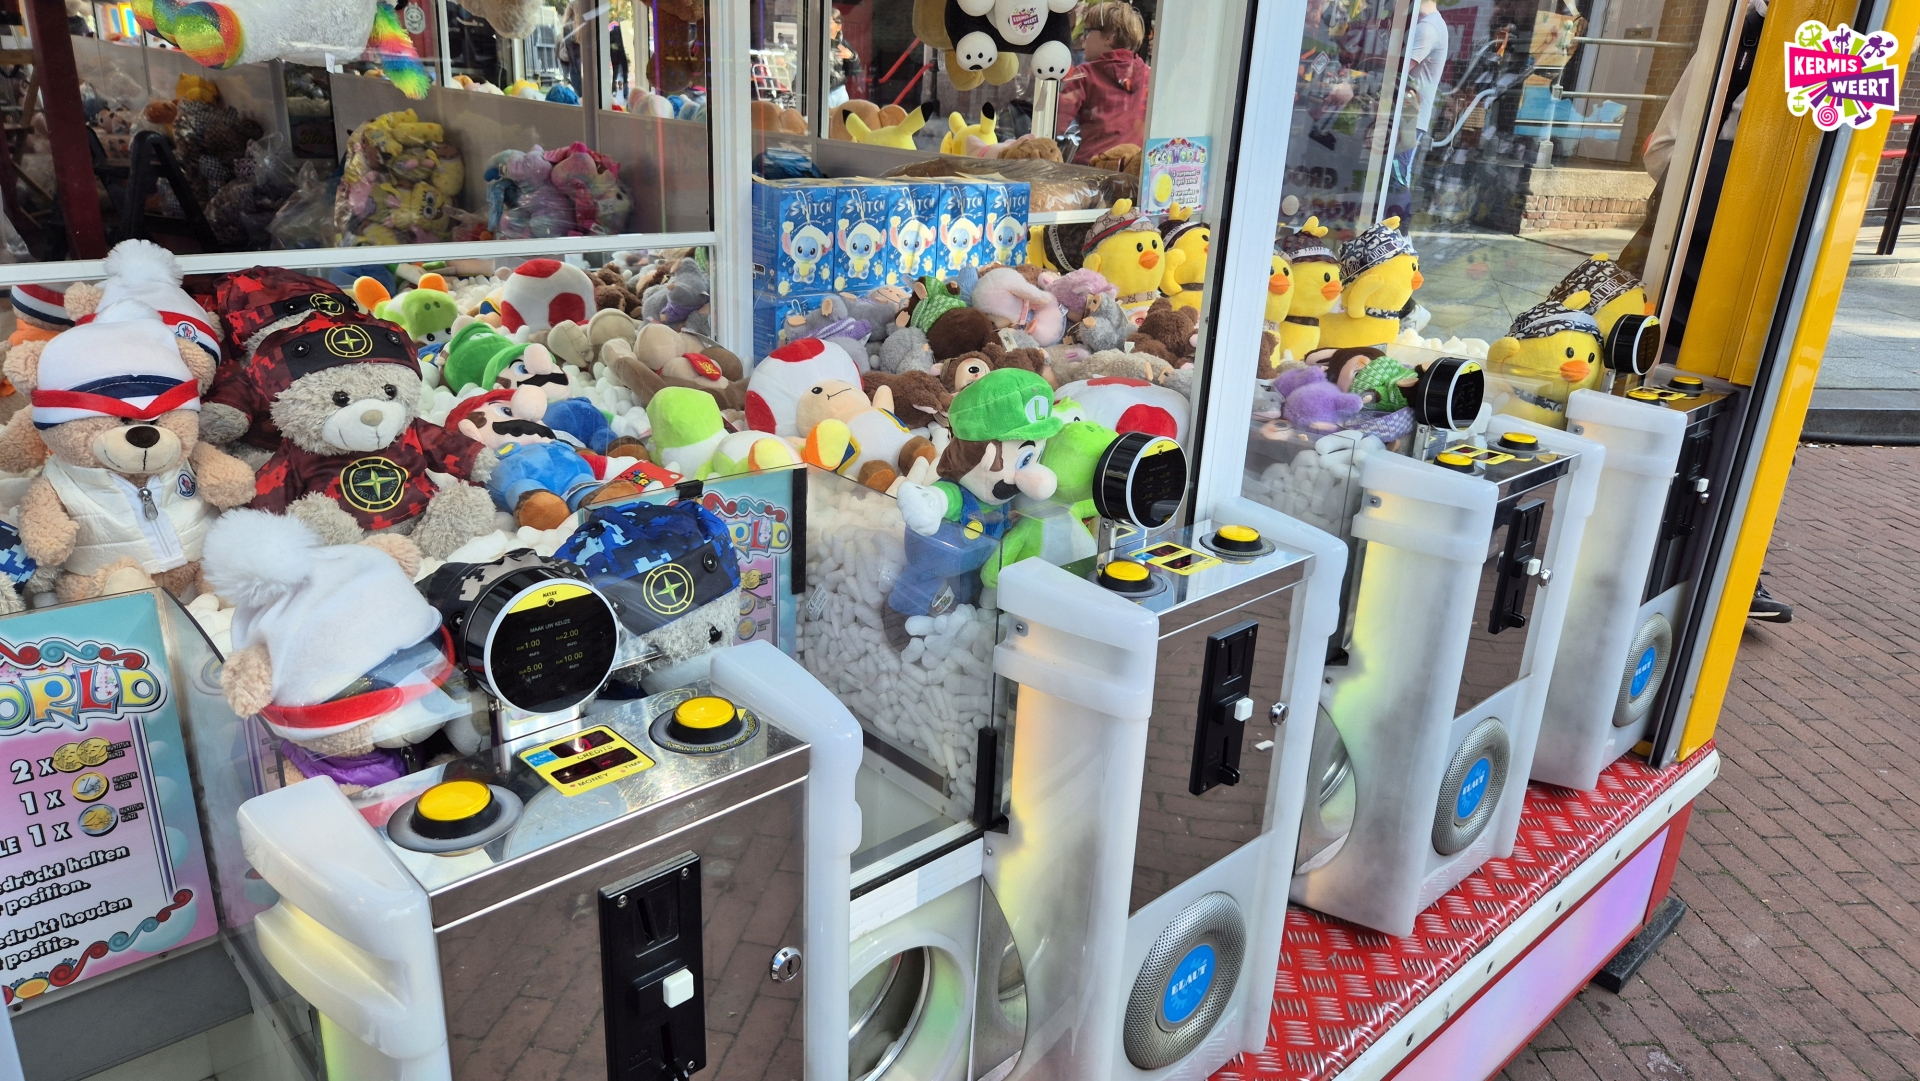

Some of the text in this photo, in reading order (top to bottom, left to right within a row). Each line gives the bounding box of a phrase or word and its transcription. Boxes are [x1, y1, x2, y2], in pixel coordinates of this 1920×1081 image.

[1034, 400, 1046, 420] L
[530, 625, 545, 633] MAAK
[563, 629, 579, 639] 2.00
[525, 639, 541, 649] 1.00
[564, 651, 583, 662] 10.00
[527, 662, 543, 673] 5.00
[577, 745, 613, 760] CREDITS
[10, 759, 34, 785] 2
[623, 760, 643, 770] TIME
[578, 772, 608, 787] MONEY
[1462, 773, 1485, 796] ELAUT
[20, 791, 38, 815] 1
[27, 823, 46, 847] 1
[66, 846, 130, 873] halten
[5, 879, 91, 916] position.
[60, 897, 133, 928] houden
[5, 936, 79, 970] positie.
[1171, 963, 1207, 996] ELAUT
